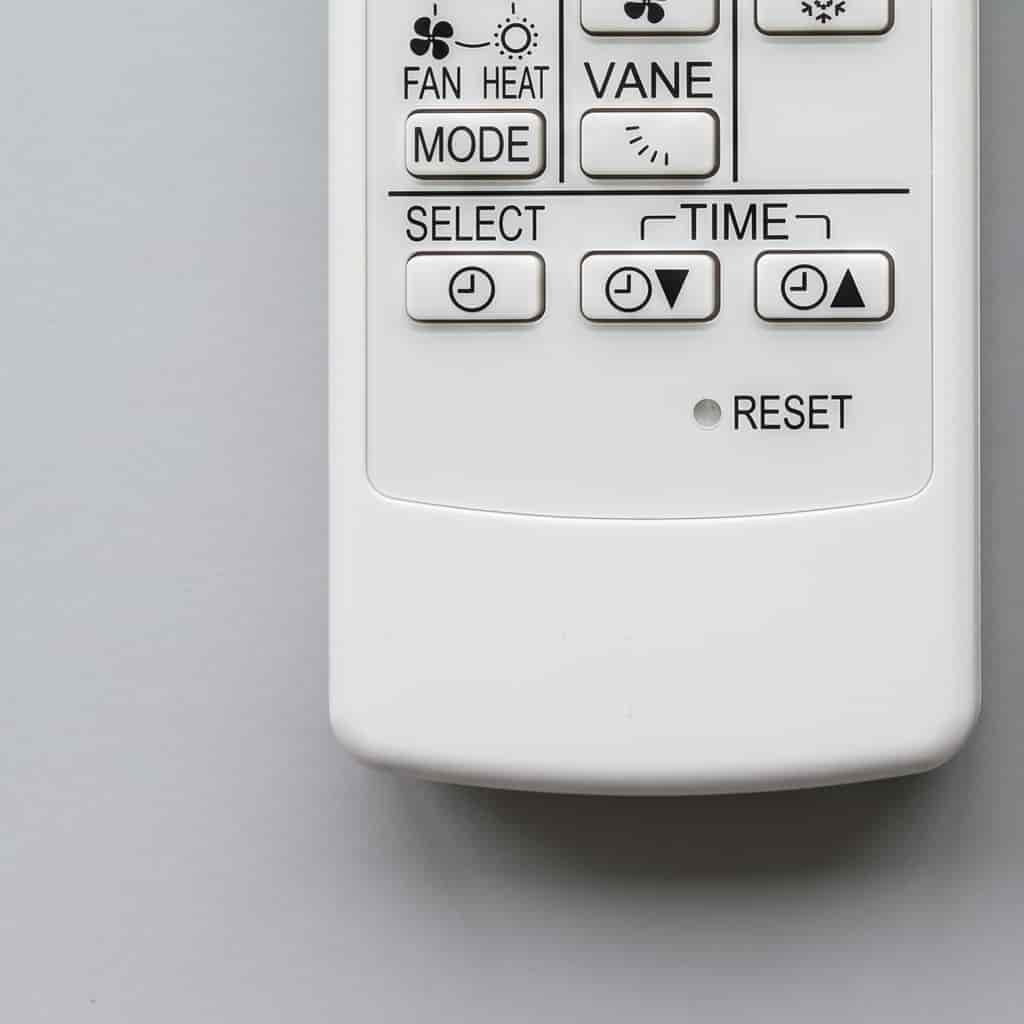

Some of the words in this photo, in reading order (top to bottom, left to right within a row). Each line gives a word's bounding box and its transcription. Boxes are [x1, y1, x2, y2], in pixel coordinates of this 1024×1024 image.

[403, 66, 461, 100] FAN
[483, 65, 550, 100] HEAT
[583, 61, 713, 99] VANE
[413, 126, 530, 162] MODE
[405, 205, 545, 242] SELECT
[680, 203, 789, 241] TIME
[733, 395, 853, 430] RESET
